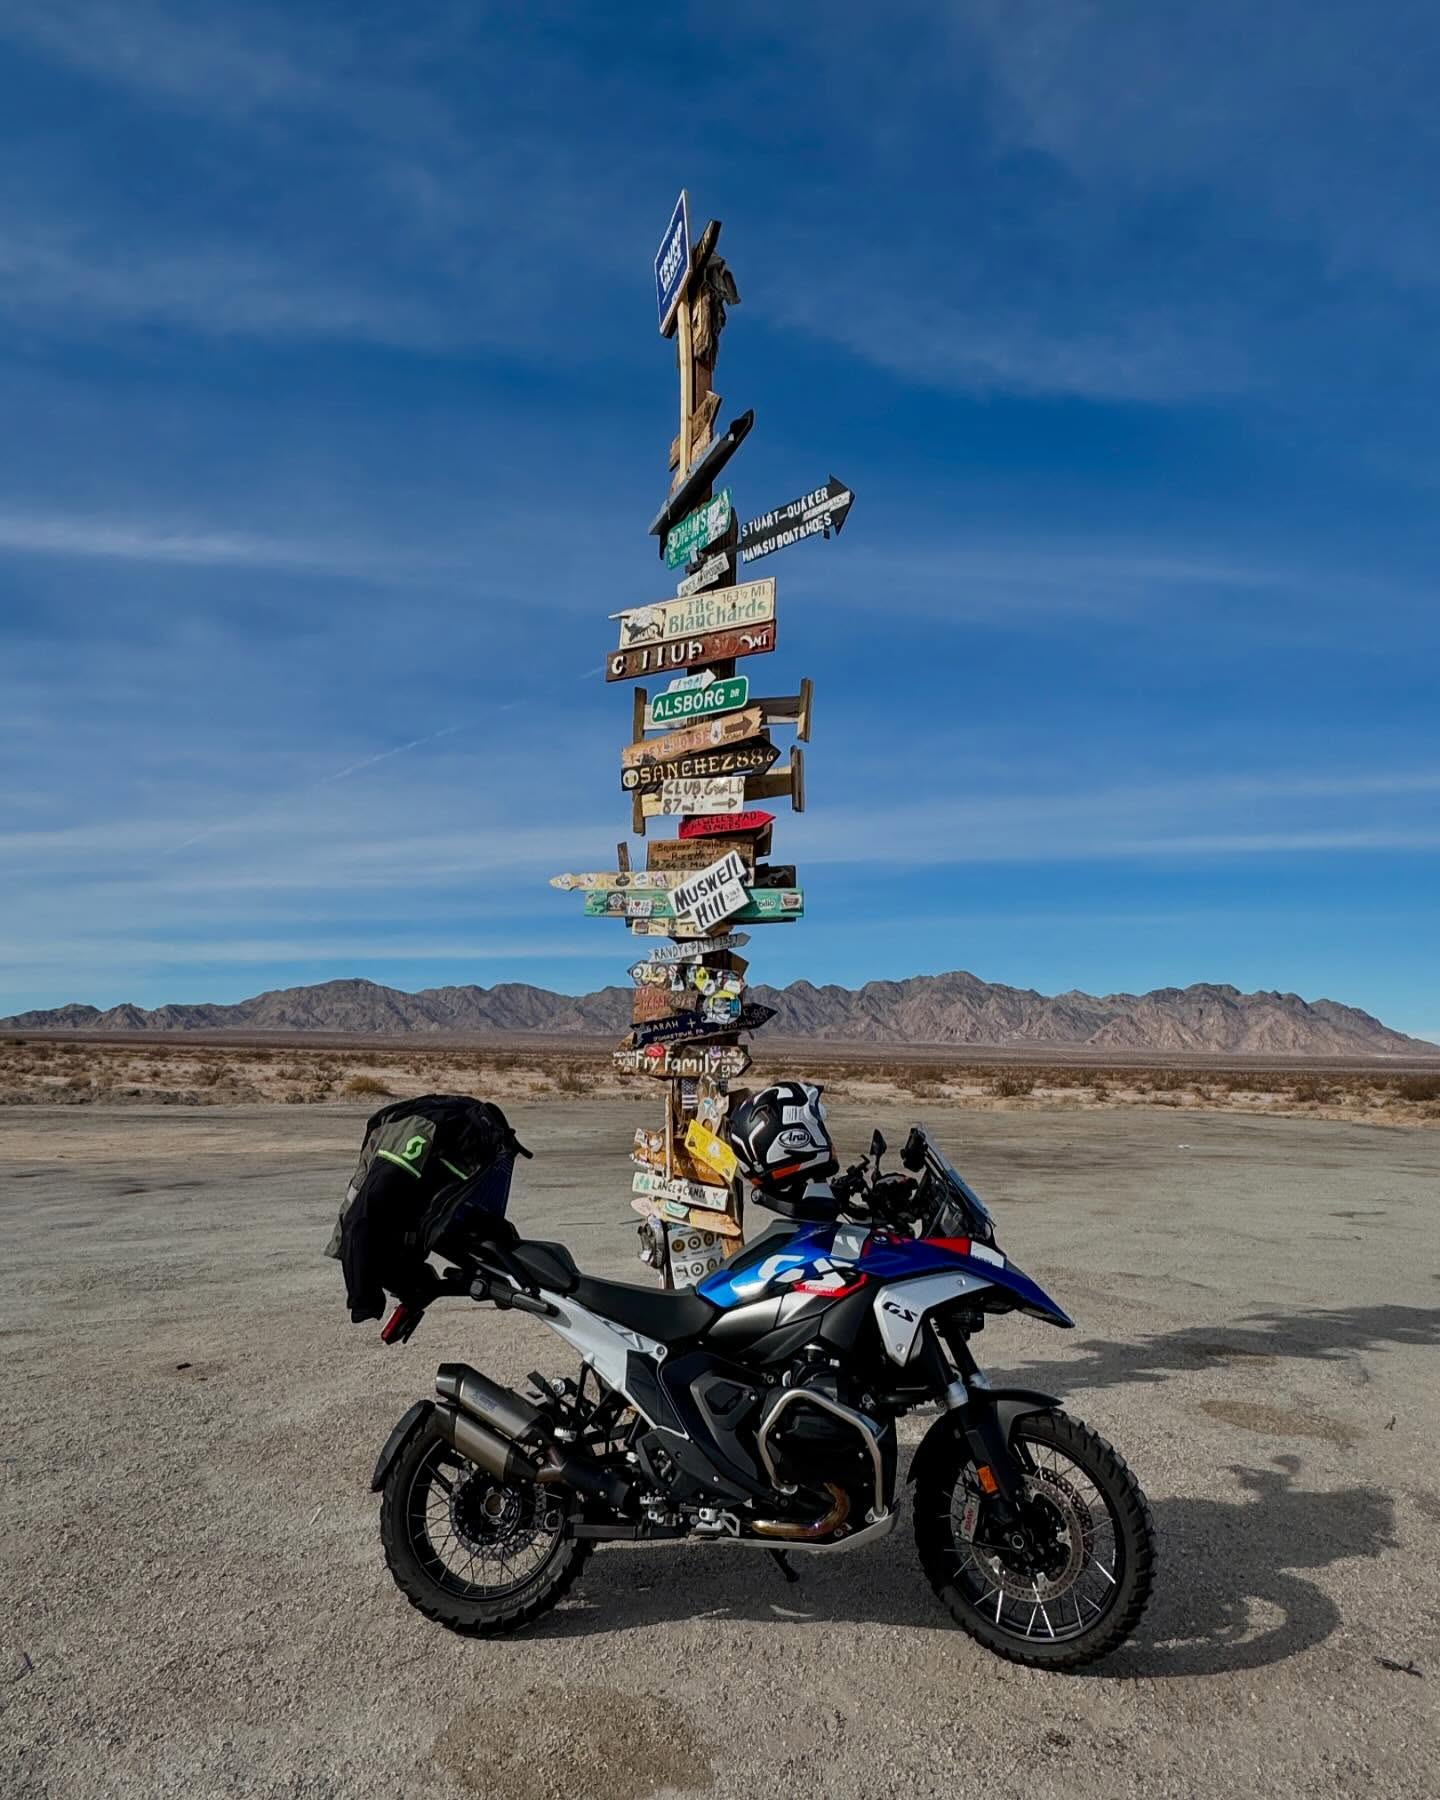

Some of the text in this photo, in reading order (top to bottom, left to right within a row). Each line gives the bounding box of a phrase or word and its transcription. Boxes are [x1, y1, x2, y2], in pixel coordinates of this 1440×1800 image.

[687, 598, 714, 615] The
[668, 598, 768, 634] Blanchards
[653, 688, 740, 718] ALSBORG DR
[663, 780, 702, 796] CLUB
[663, 798, 682, 814] 87
[654, 945, 684, 960] RANDY
[636, 1050, 660, 1071] Fry
[664, 1050, 720, 1074] Family
[652, 1180, 677, 1194] LANCE
[883, 1301, 918, 1323] GS
